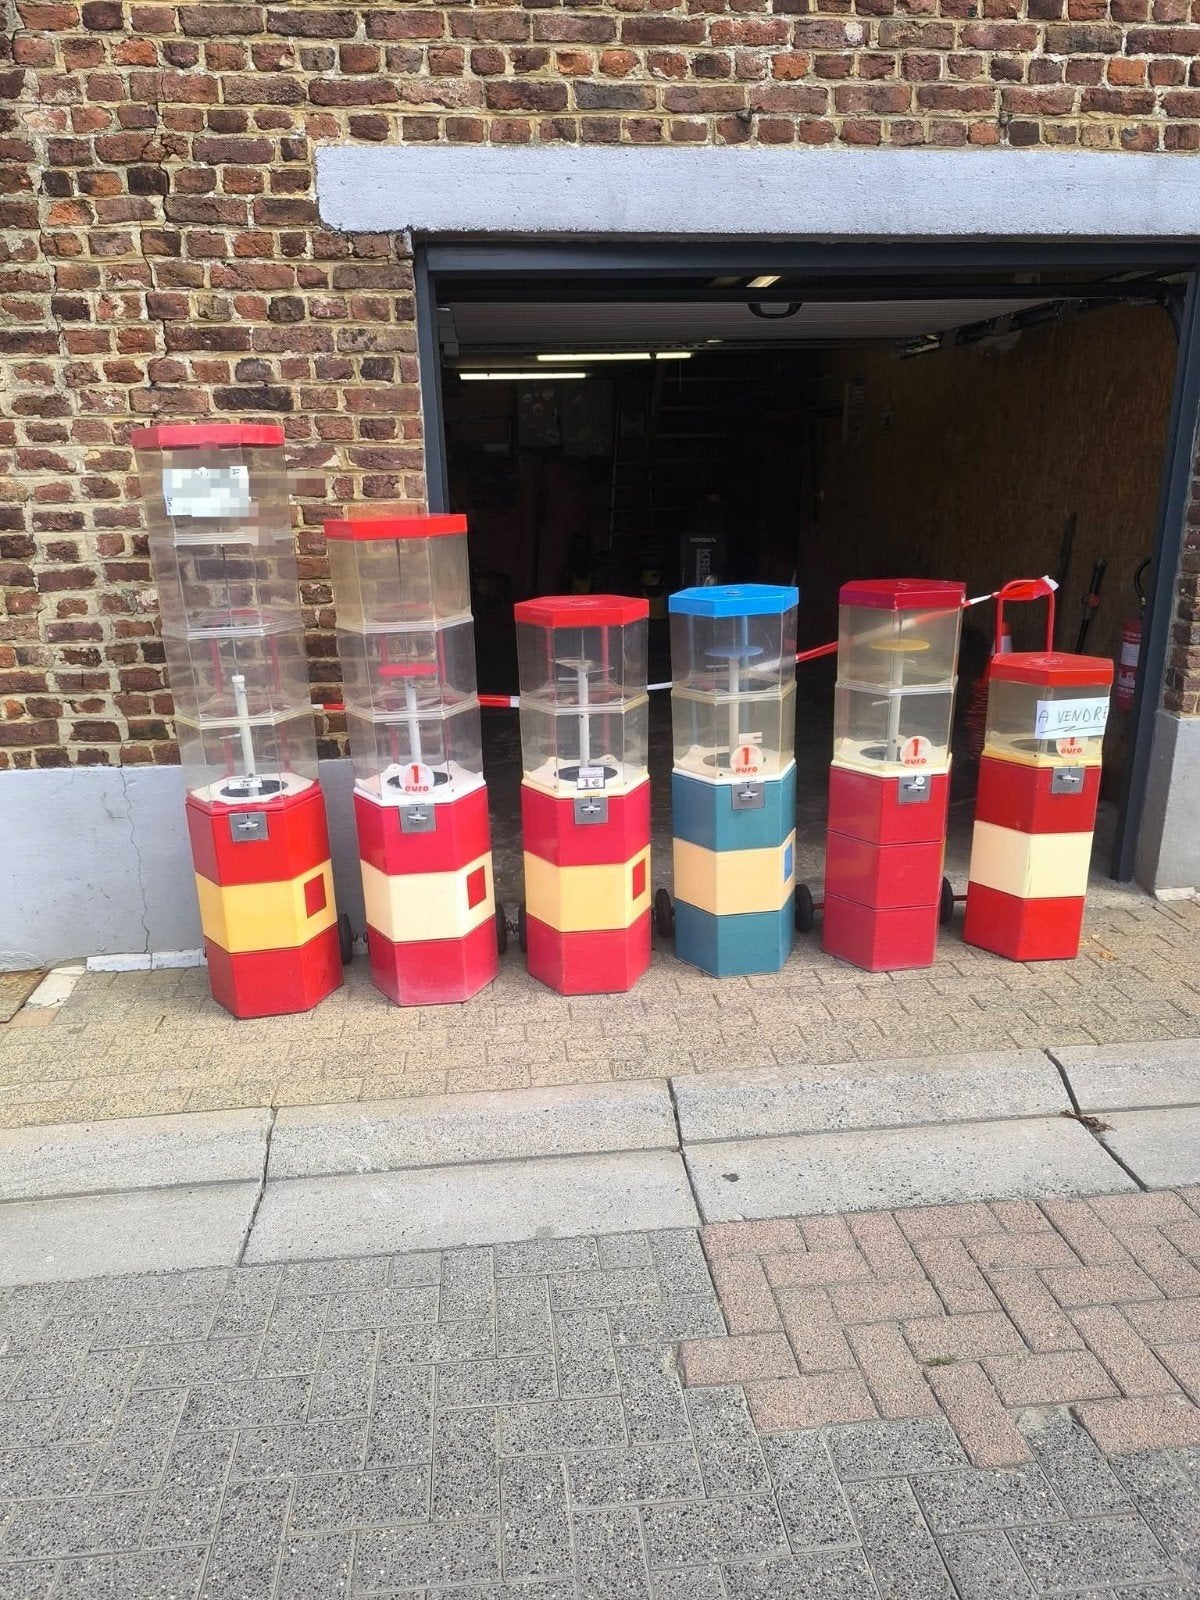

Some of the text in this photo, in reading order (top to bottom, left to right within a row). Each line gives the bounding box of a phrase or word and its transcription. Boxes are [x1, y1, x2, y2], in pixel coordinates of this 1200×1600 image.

[1038, 709, 1049, 723] A
[742, 747, 750, 765] 1
[912, 738, 919, 757] 1
[411, 765, 419, 784] 1
